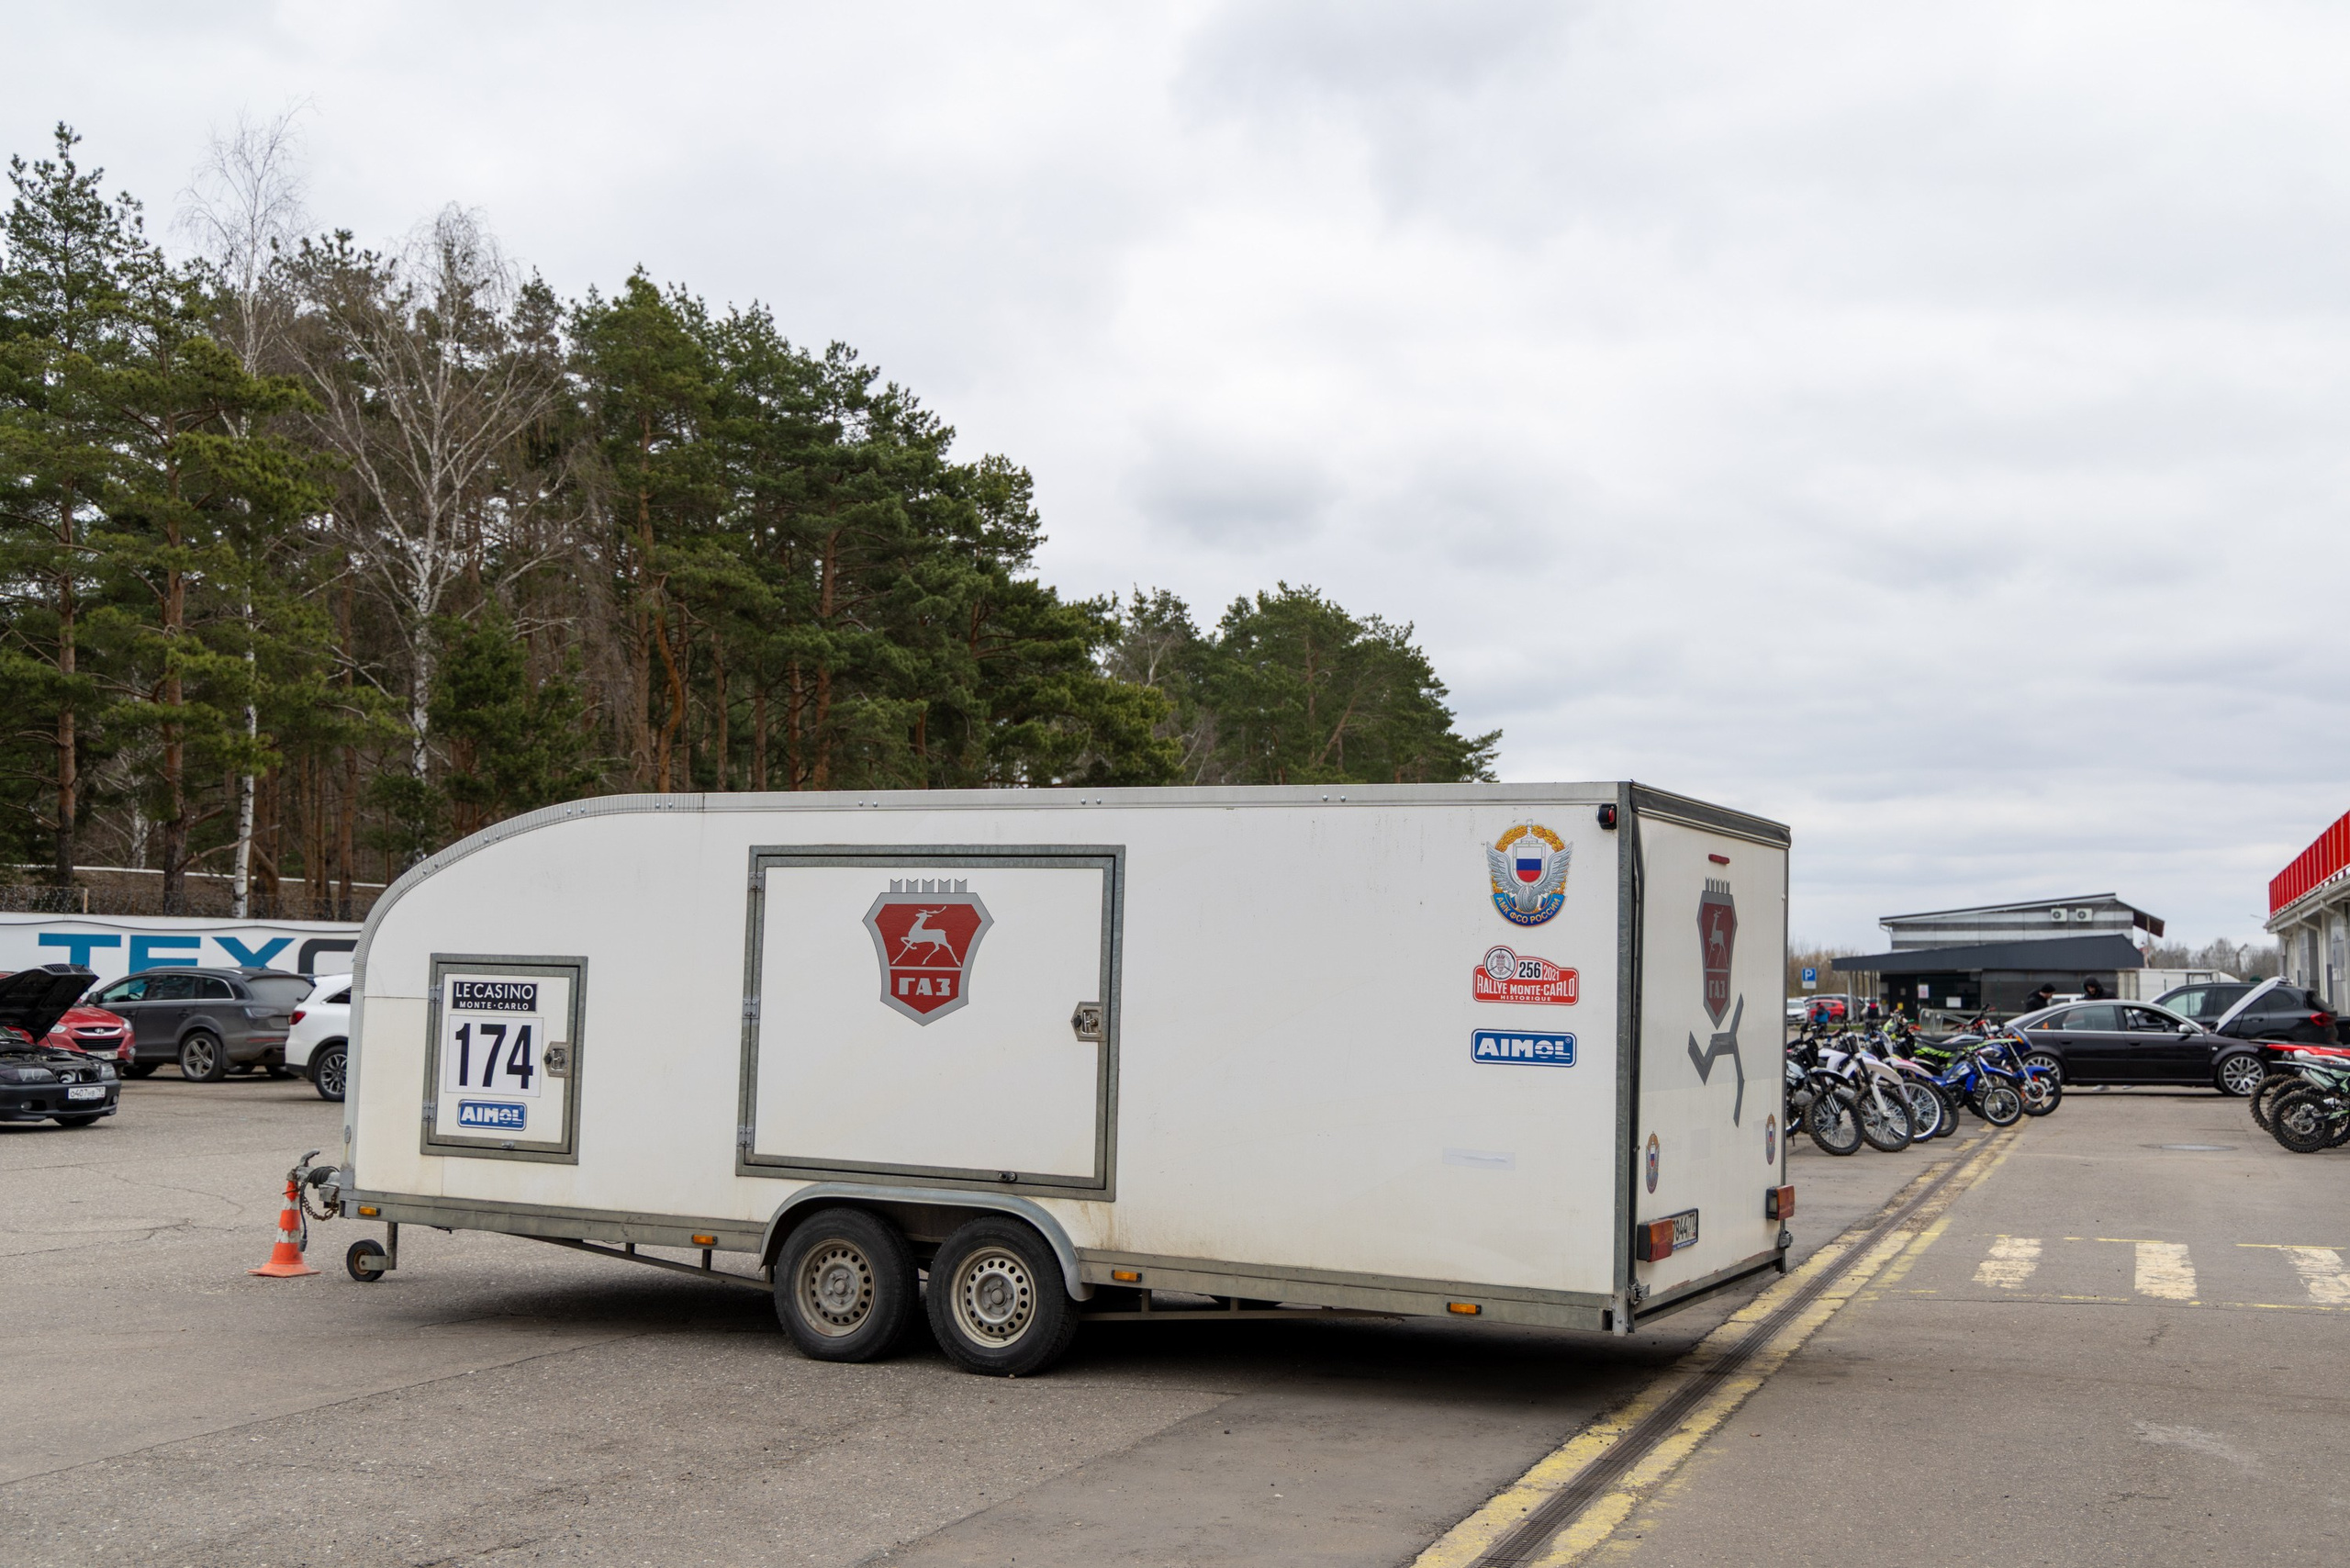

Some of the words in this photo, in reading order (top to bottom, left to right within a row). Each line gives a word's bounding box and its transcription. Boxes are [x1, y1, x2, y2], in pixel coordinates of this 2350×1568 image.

[1496, 897, 1511, 914] АМК
[1509, 912, 1528, 924] ФСО
[1530, 898, 1561, 924] РОССИИ
[1519, 961, 1541, 979] 256
[1543, 965, 1560, 981] 2021
[1804, 969, 1814, 980] P
[455, 983, 471, 998] LE
[474, 983, 534, 1000] CASINO
[898, 978, 951, 996] ГАЗ
[1477, 974, 1507, 994] RALLYE
[1510, 978, 1575, 997] MONTE-CARLO
[1708, 980, 1726, 999] ГАЗ
[455, 1023, 533, 1090] 174
[1476, 1037, 1571, 1059] AIMOL
[461, 1106, 523, 1125] AIMOL
